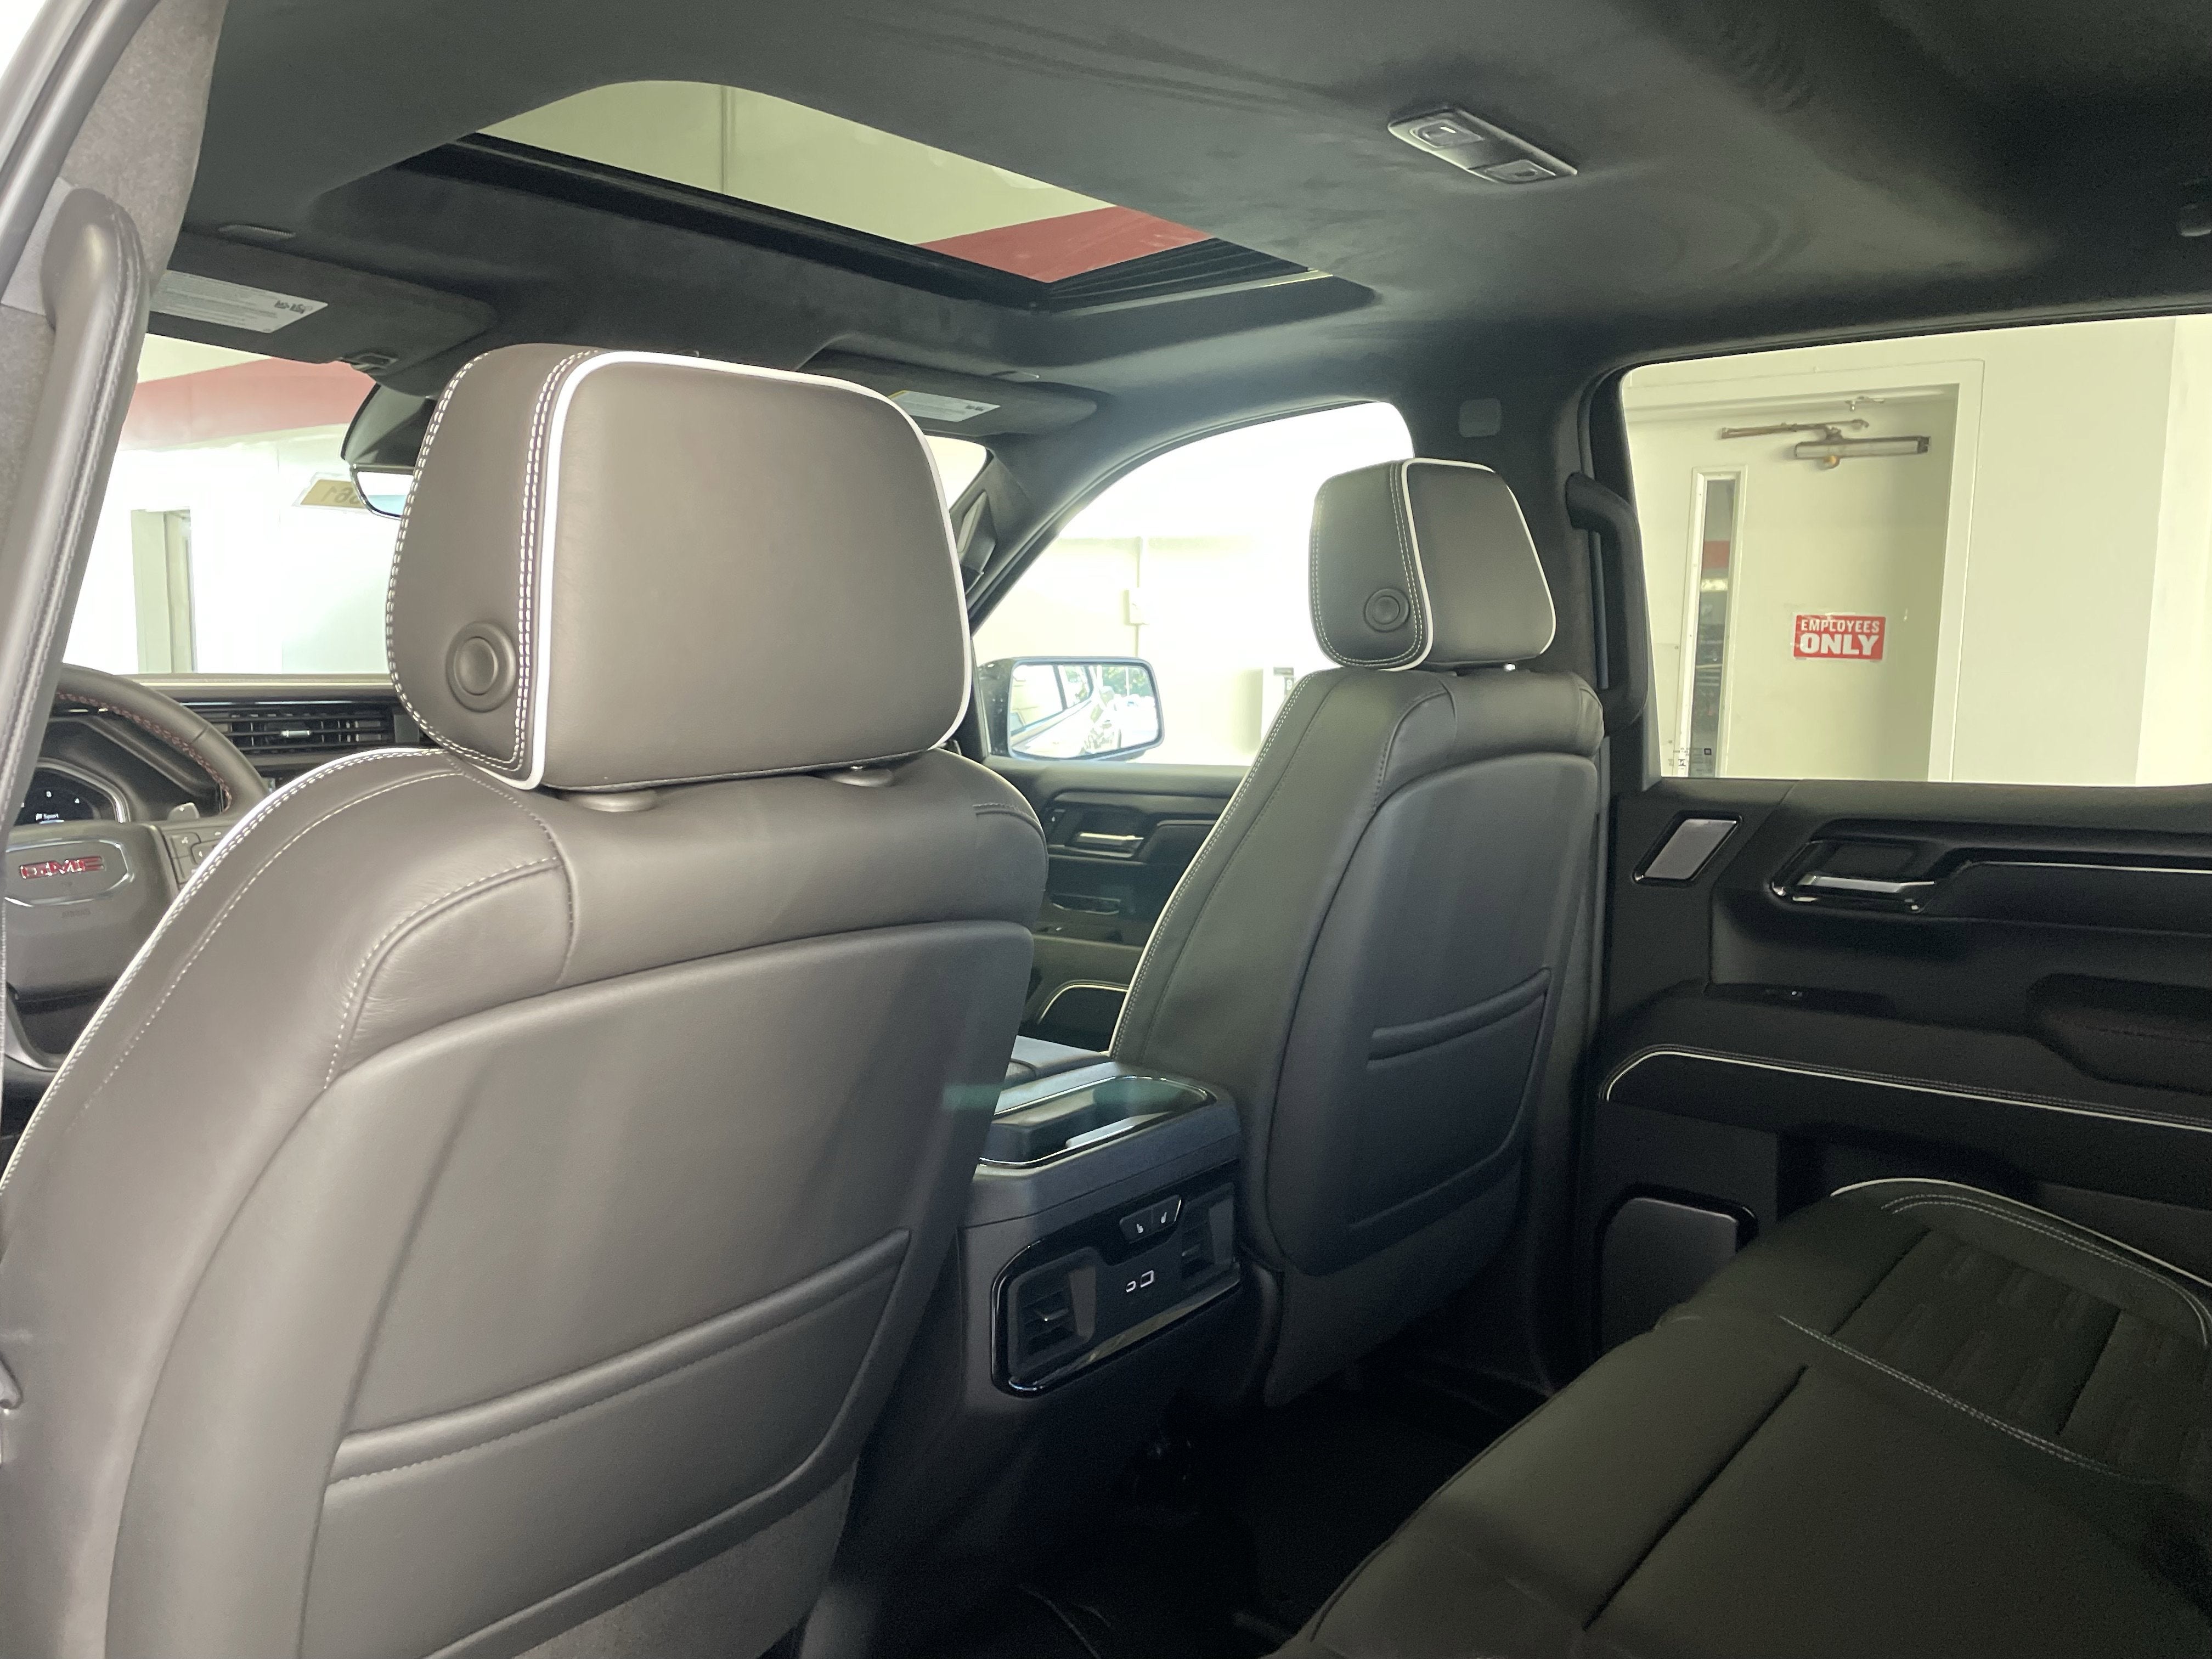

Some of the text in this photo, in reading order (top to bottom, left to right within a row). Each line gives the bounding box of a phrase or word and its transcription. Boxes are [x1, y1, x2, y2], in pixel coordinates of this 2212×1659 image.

[1801, 619, 1880, 633] EMPLOYEES
[1800, 633, 1879, 655] ONLY
[20, 857, 104, 879] GMC
